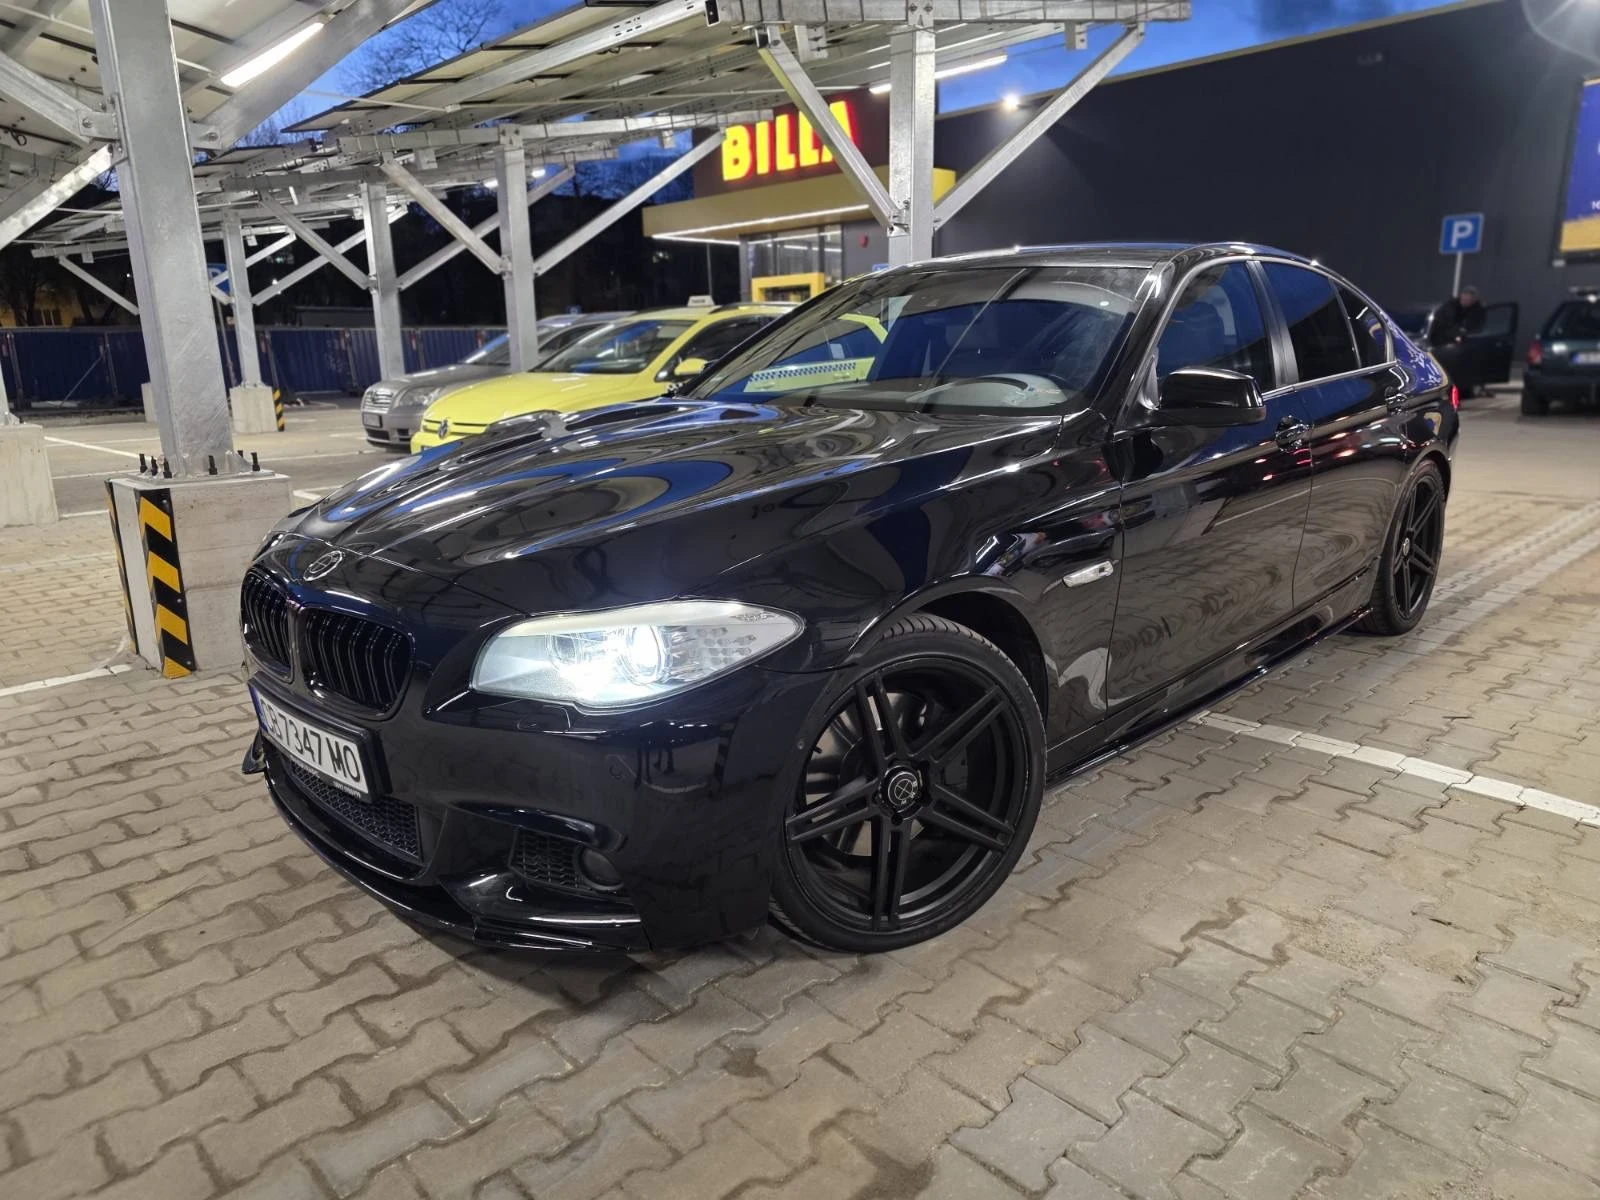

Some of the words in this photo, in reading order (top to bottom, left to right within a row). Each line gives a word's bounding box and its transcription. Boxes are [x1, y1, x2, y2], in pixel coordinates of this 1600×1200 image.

[1450, 220, 1474, 248] P
[278, 714, 322, 765] 7347
[326, 736, 361, 783] MO
